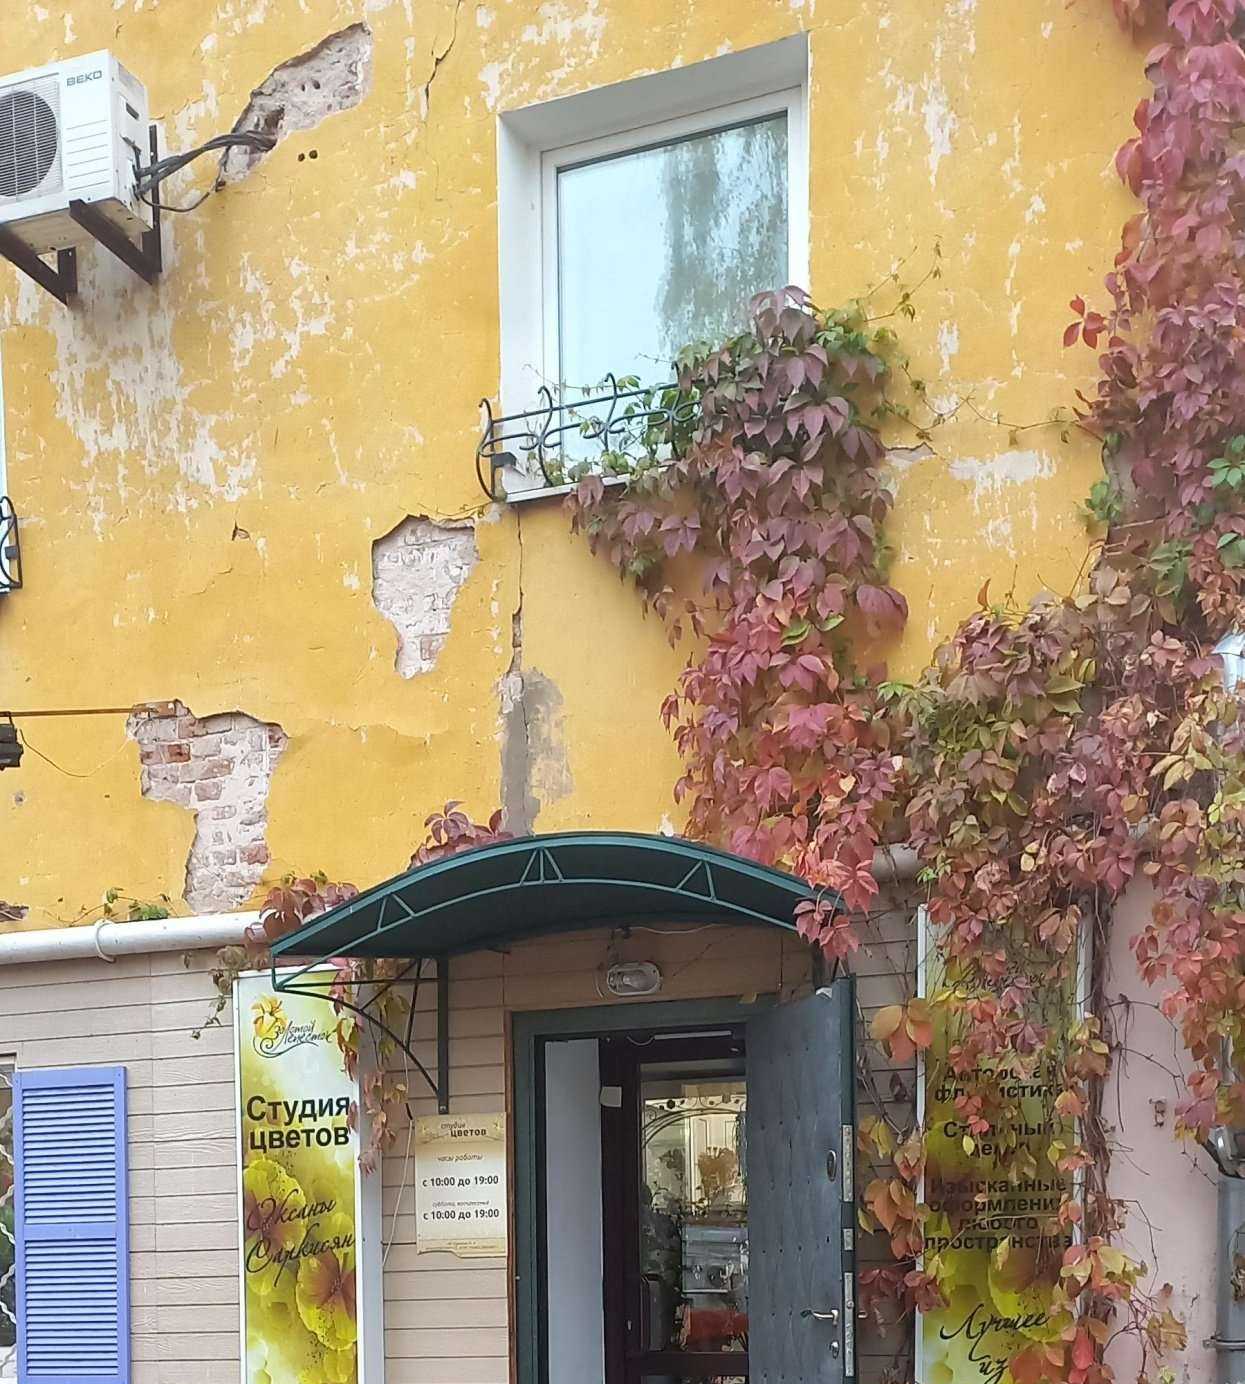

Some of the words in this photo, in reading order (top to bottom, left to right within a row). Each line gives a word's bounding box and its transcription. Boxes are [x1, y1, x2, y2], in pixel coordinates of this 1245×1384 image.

[66, 70, 103, 87] BEKO
[246, 1095, 350, 1126] Студия
[249, 1126, 350, 1154] цветов
[450, 1129, 487, 1138] цветов
[422, 1179, 428, 1187] с
[431, 1177, 455, 1187] 10:00
[458, 1178, 471, 1187] до
[475, 1175, 499, 1185] 19:00
[247, 1188, 337, 1232] Оксаны
[423, 1212, 429, 1220] с
[431, 1210, 456, 1220] 10:00
[458, 1211, 471, 1220] до
[475, 1208, 500, 1218] 19:00
[246, 1222, 355, 1287] Саркисян
[939, 1303, 1051, 1362] Лучшее
